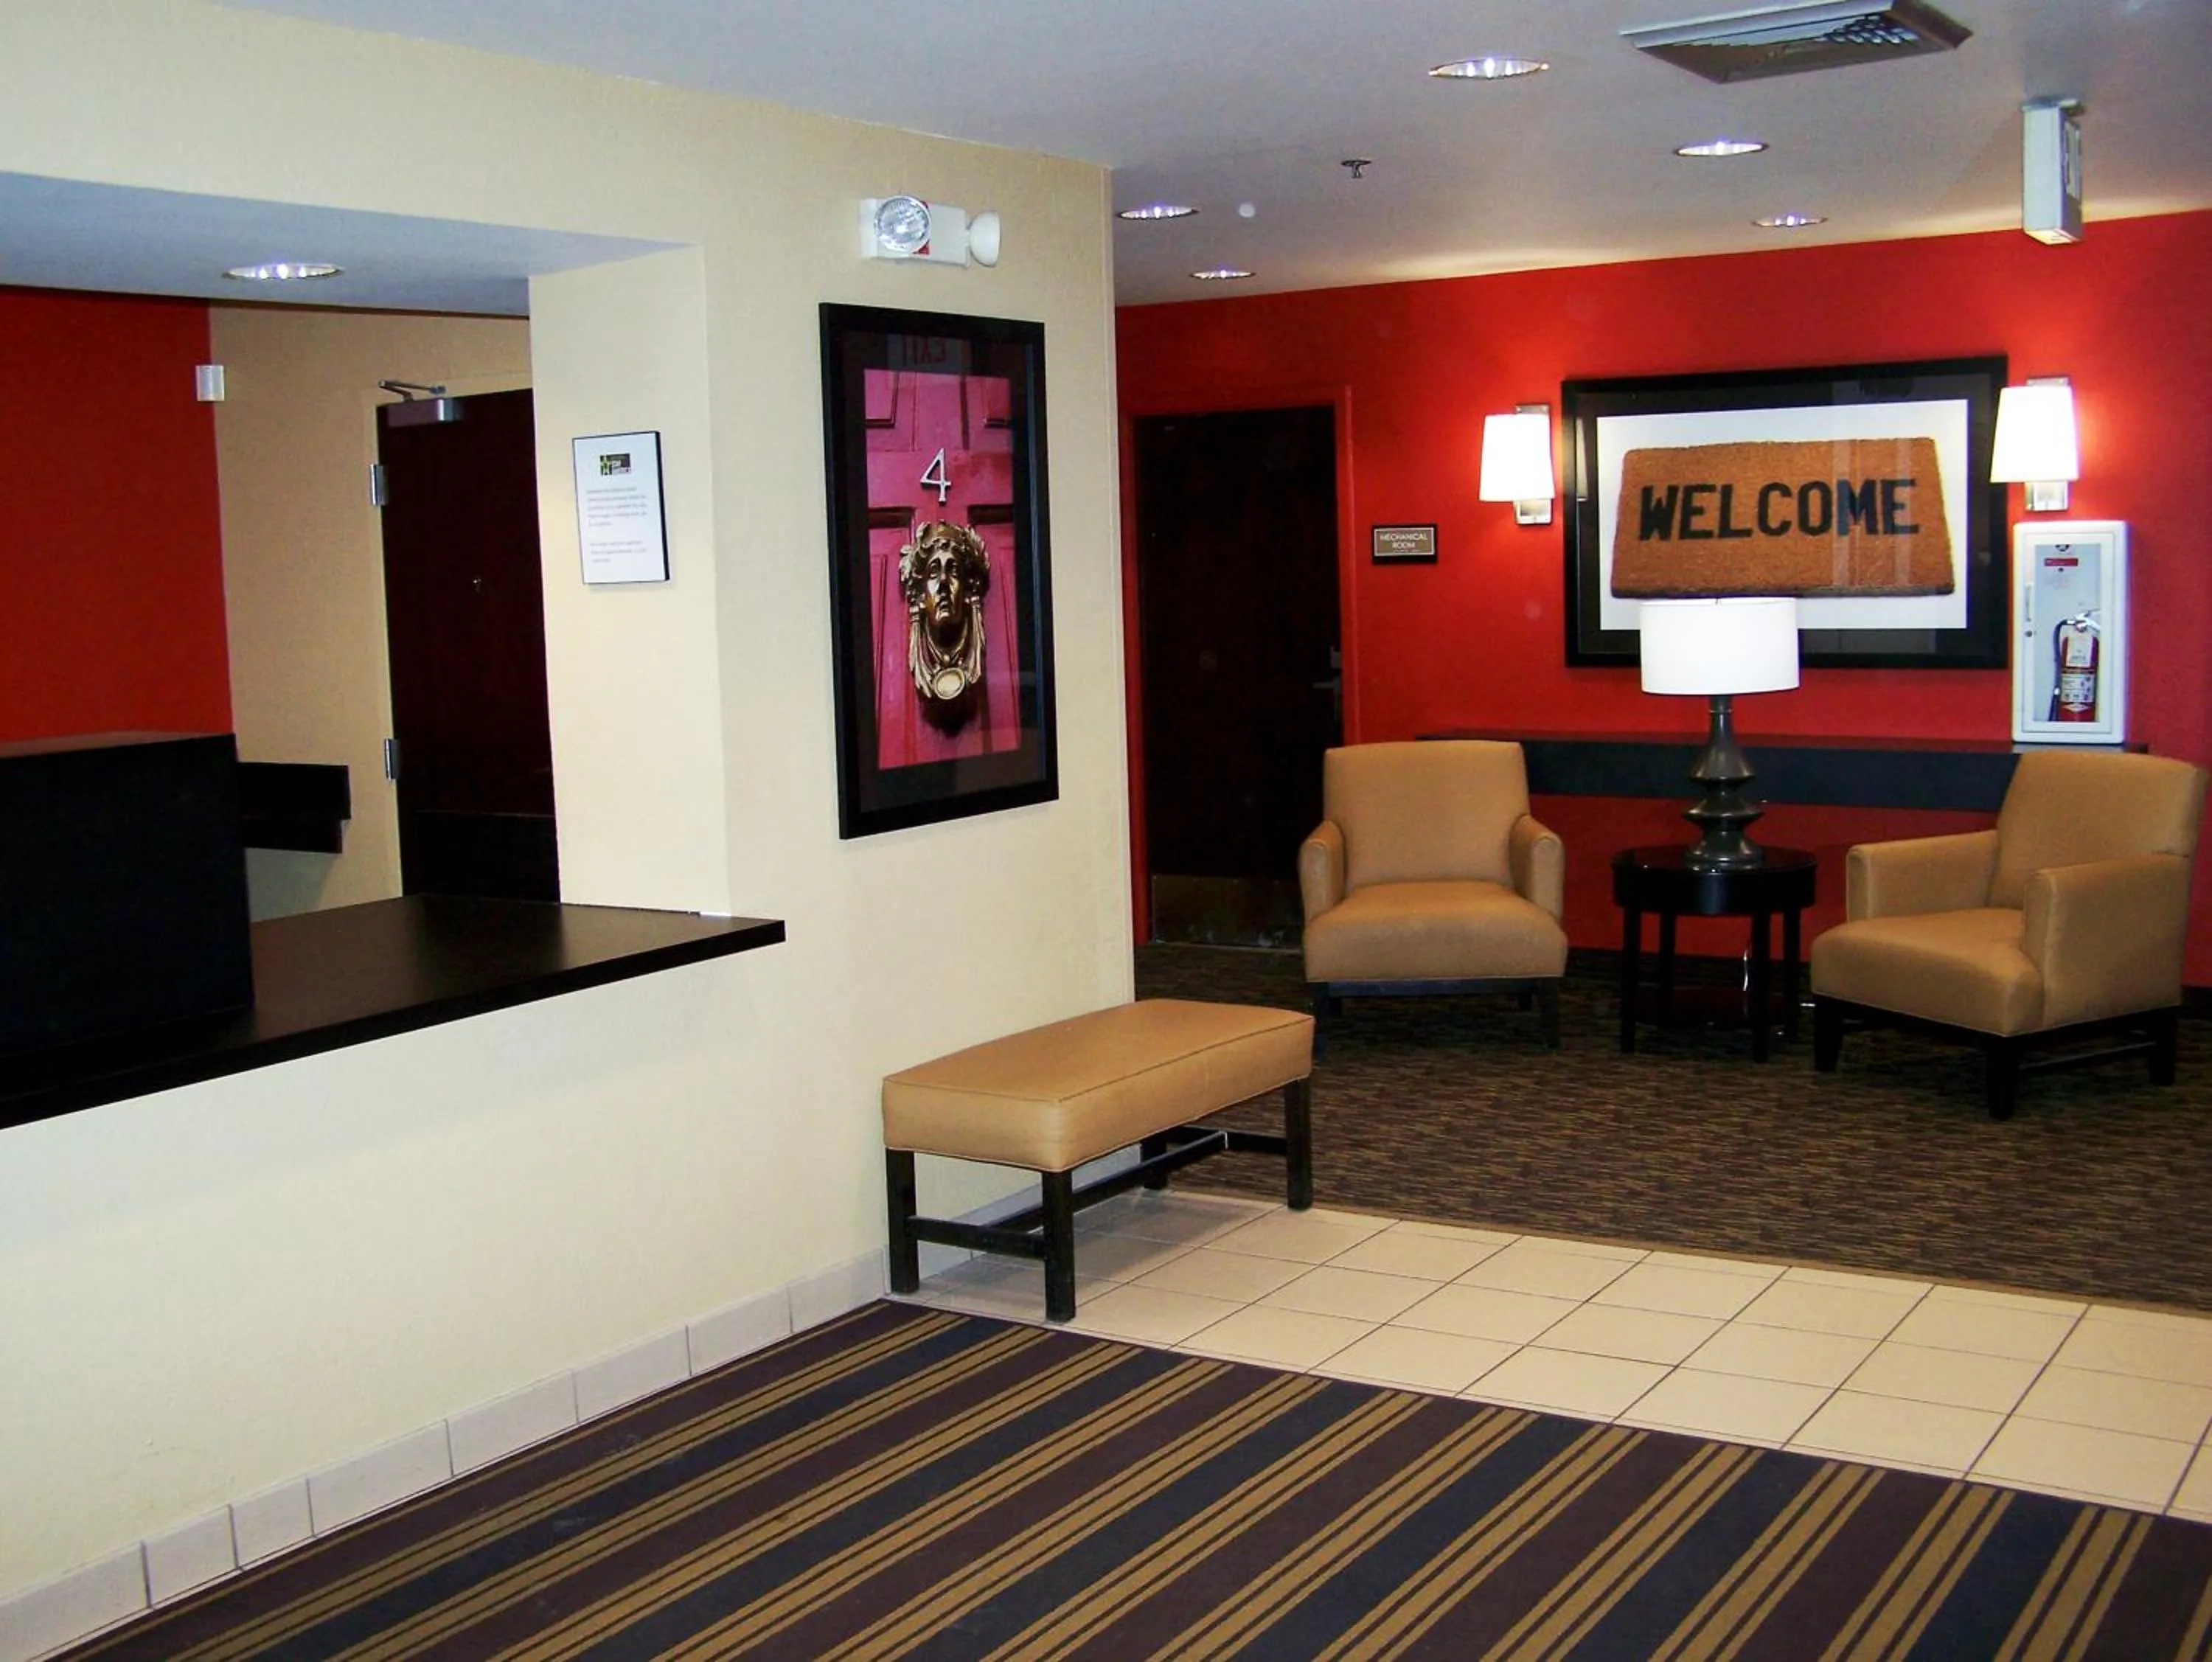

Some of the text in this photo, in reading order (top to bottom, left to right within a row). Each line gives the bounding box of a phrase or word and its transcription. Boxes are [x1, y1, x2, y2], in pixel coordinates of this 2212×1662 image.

[920, 448, 952, 503] 4
[1638, 477, 1920, 541] WELCOME
[1380, 532, 1428, 541] MECHANICAL
[1391, 541, 1416, 549] ROOM
